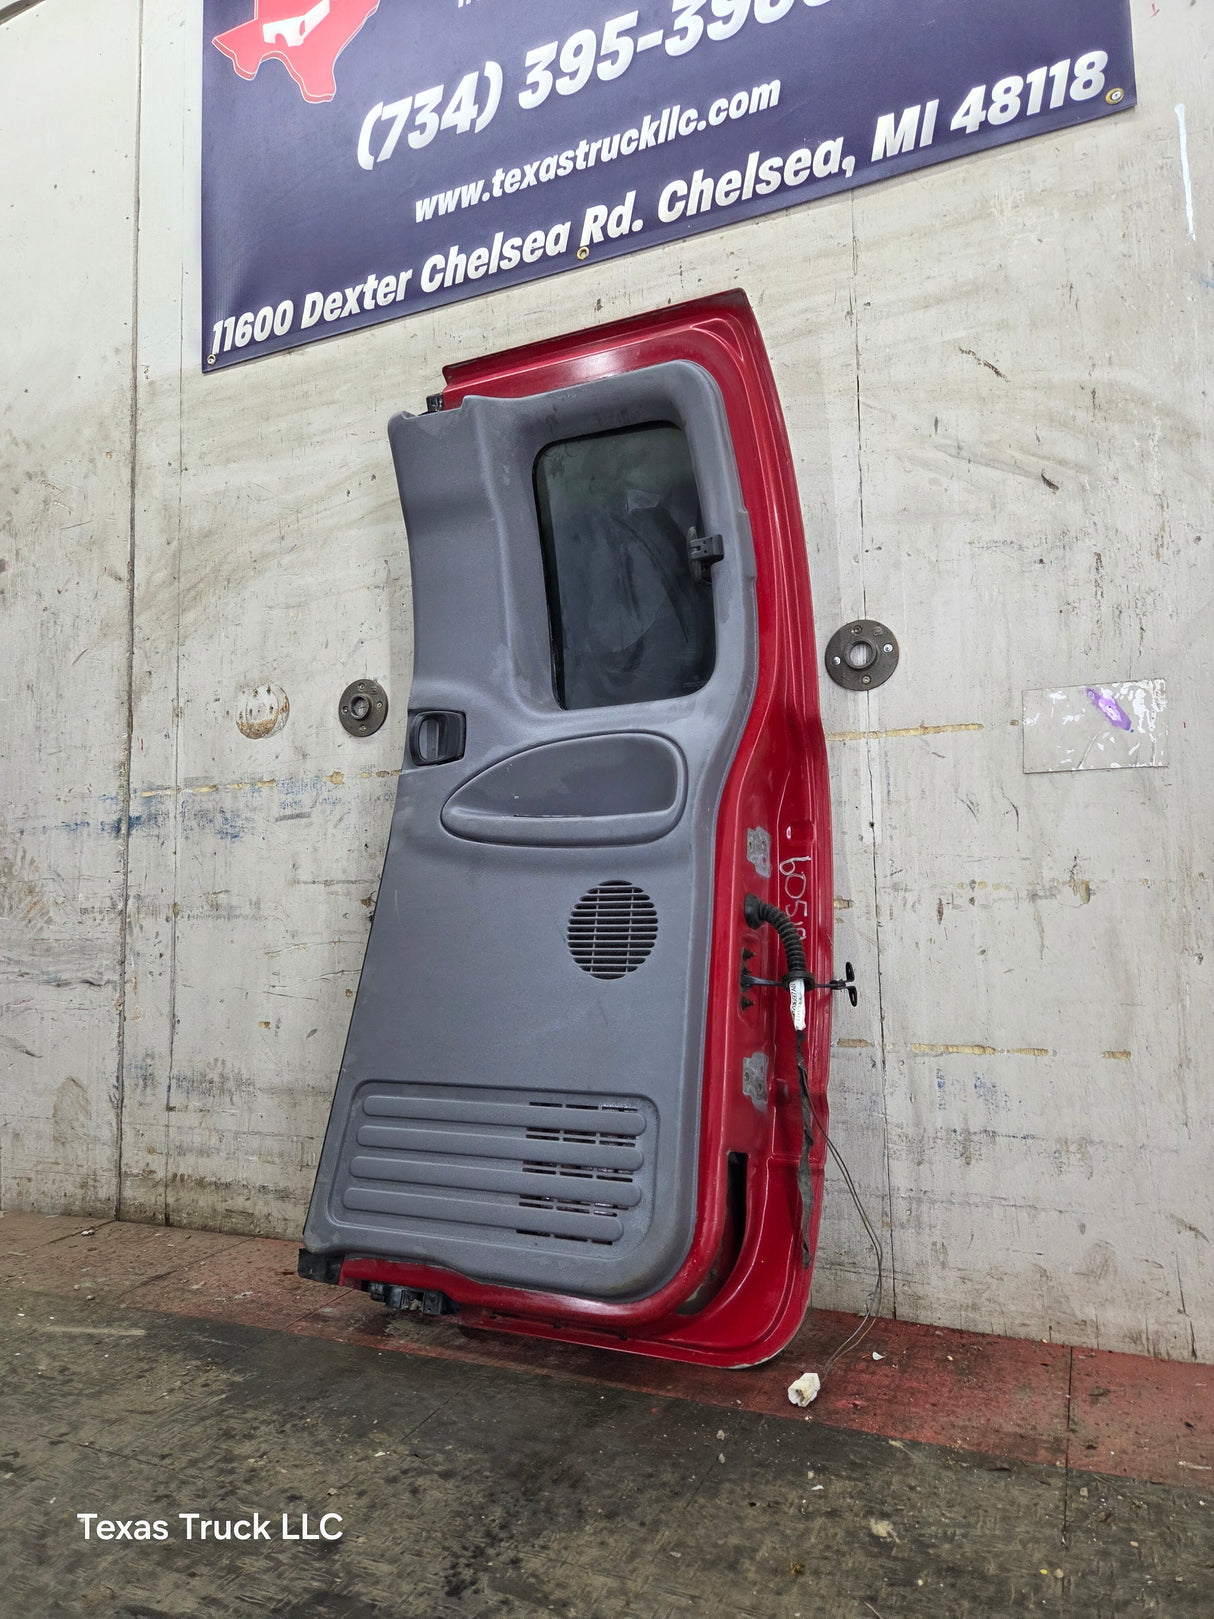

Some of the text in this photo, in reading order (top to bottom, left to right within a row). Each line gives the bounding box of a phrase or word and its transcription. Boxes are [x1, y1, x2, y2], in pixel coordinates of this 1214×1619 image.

[356, 0, 832, 171] (734) 395-39
[415, 79, 781, 223] www.texastruckllc.com
[208, 50, 1109, 360] 11600 Dexter Chelsea Rd. Chelsea, MI 48118
